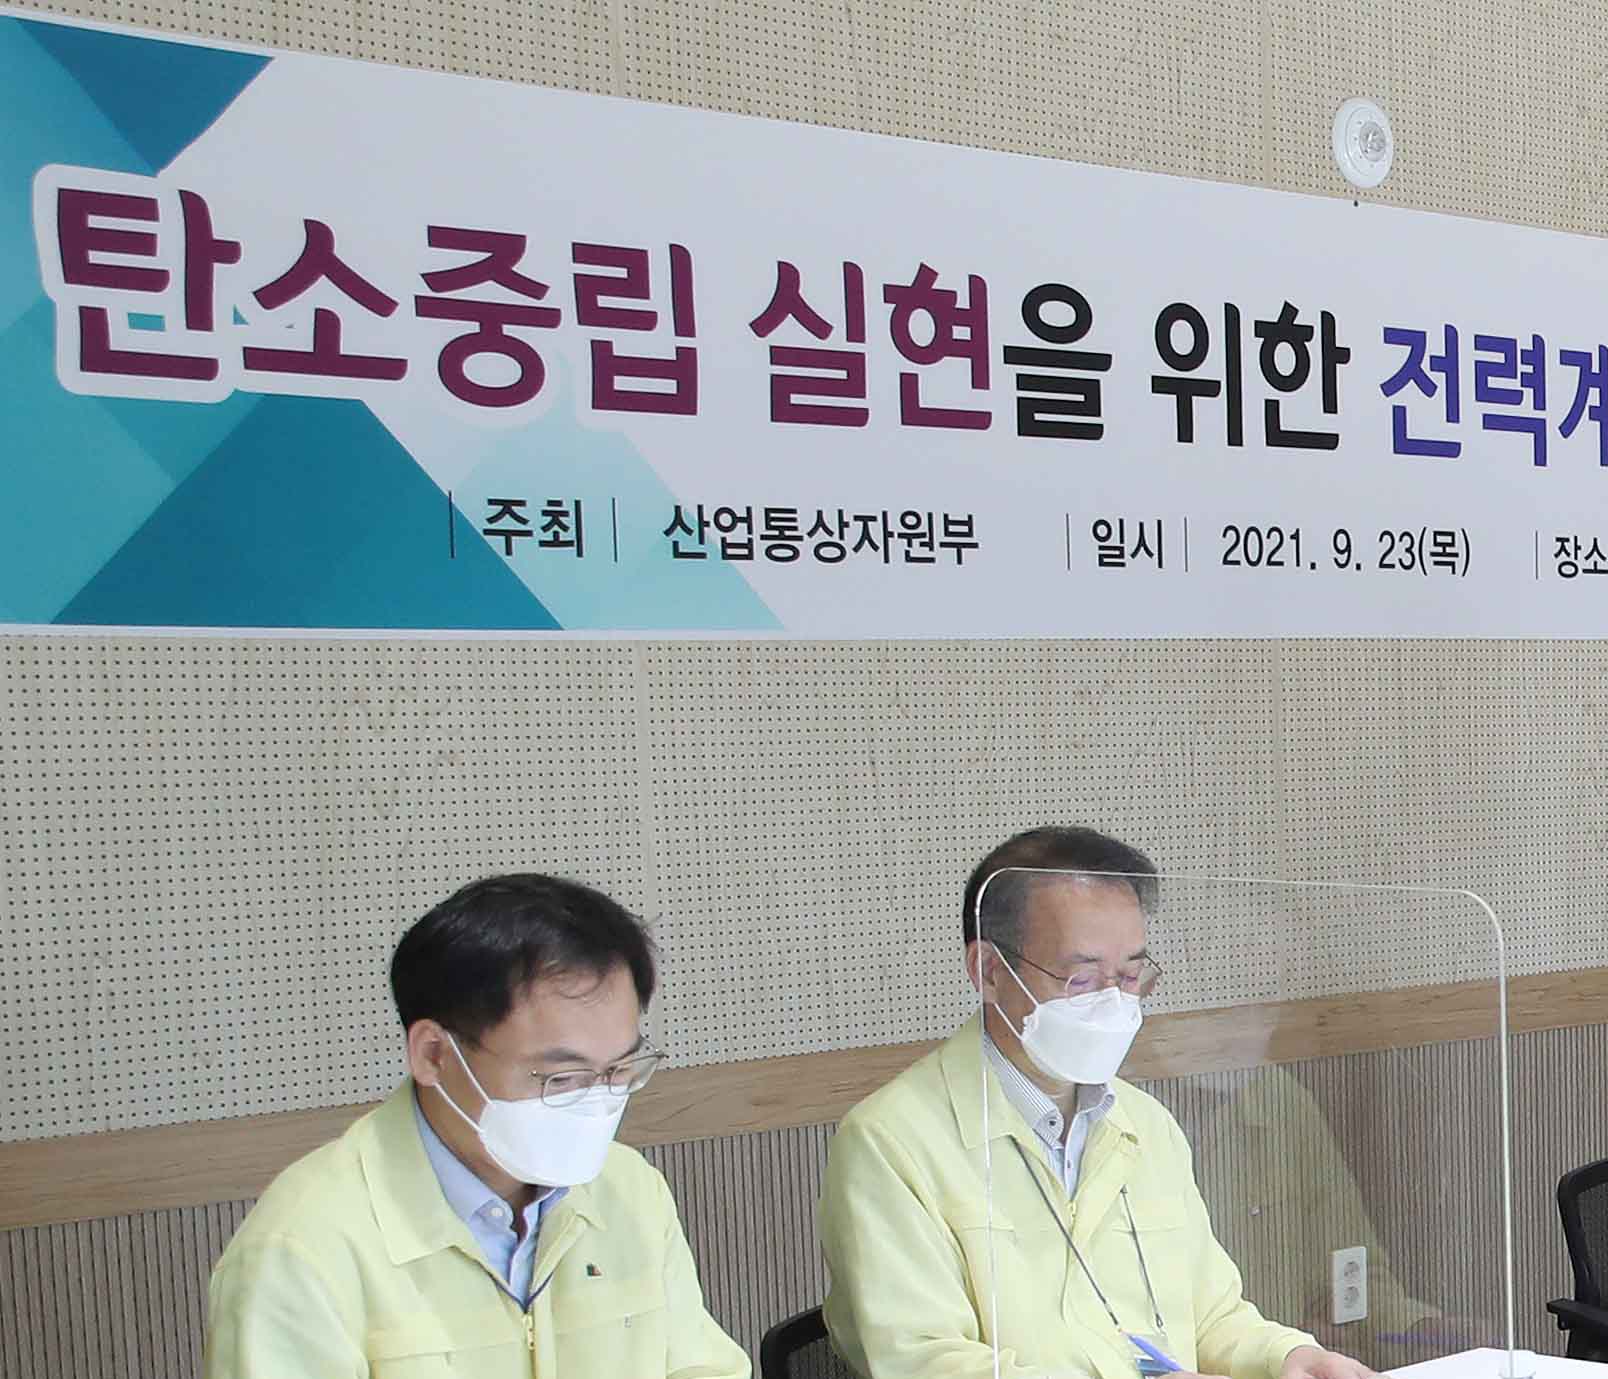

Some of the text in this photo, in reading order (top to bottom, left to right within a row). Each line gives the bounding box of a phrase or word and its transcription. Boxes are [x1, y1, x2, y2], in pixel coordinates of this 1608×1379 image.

[58, 188, 699, 417] 탄소중립
[750, 261, 1112, 442] 실현을
[1150, 299, 1352, 452] 위한
[482, 497, 585, 560] 주최
[662, 503, 980, 567] 산업통상자원부
[1091, 517, 1164, 570] 일시
[1221, 523, 1471, 578] 2021. 9. 23(목)
